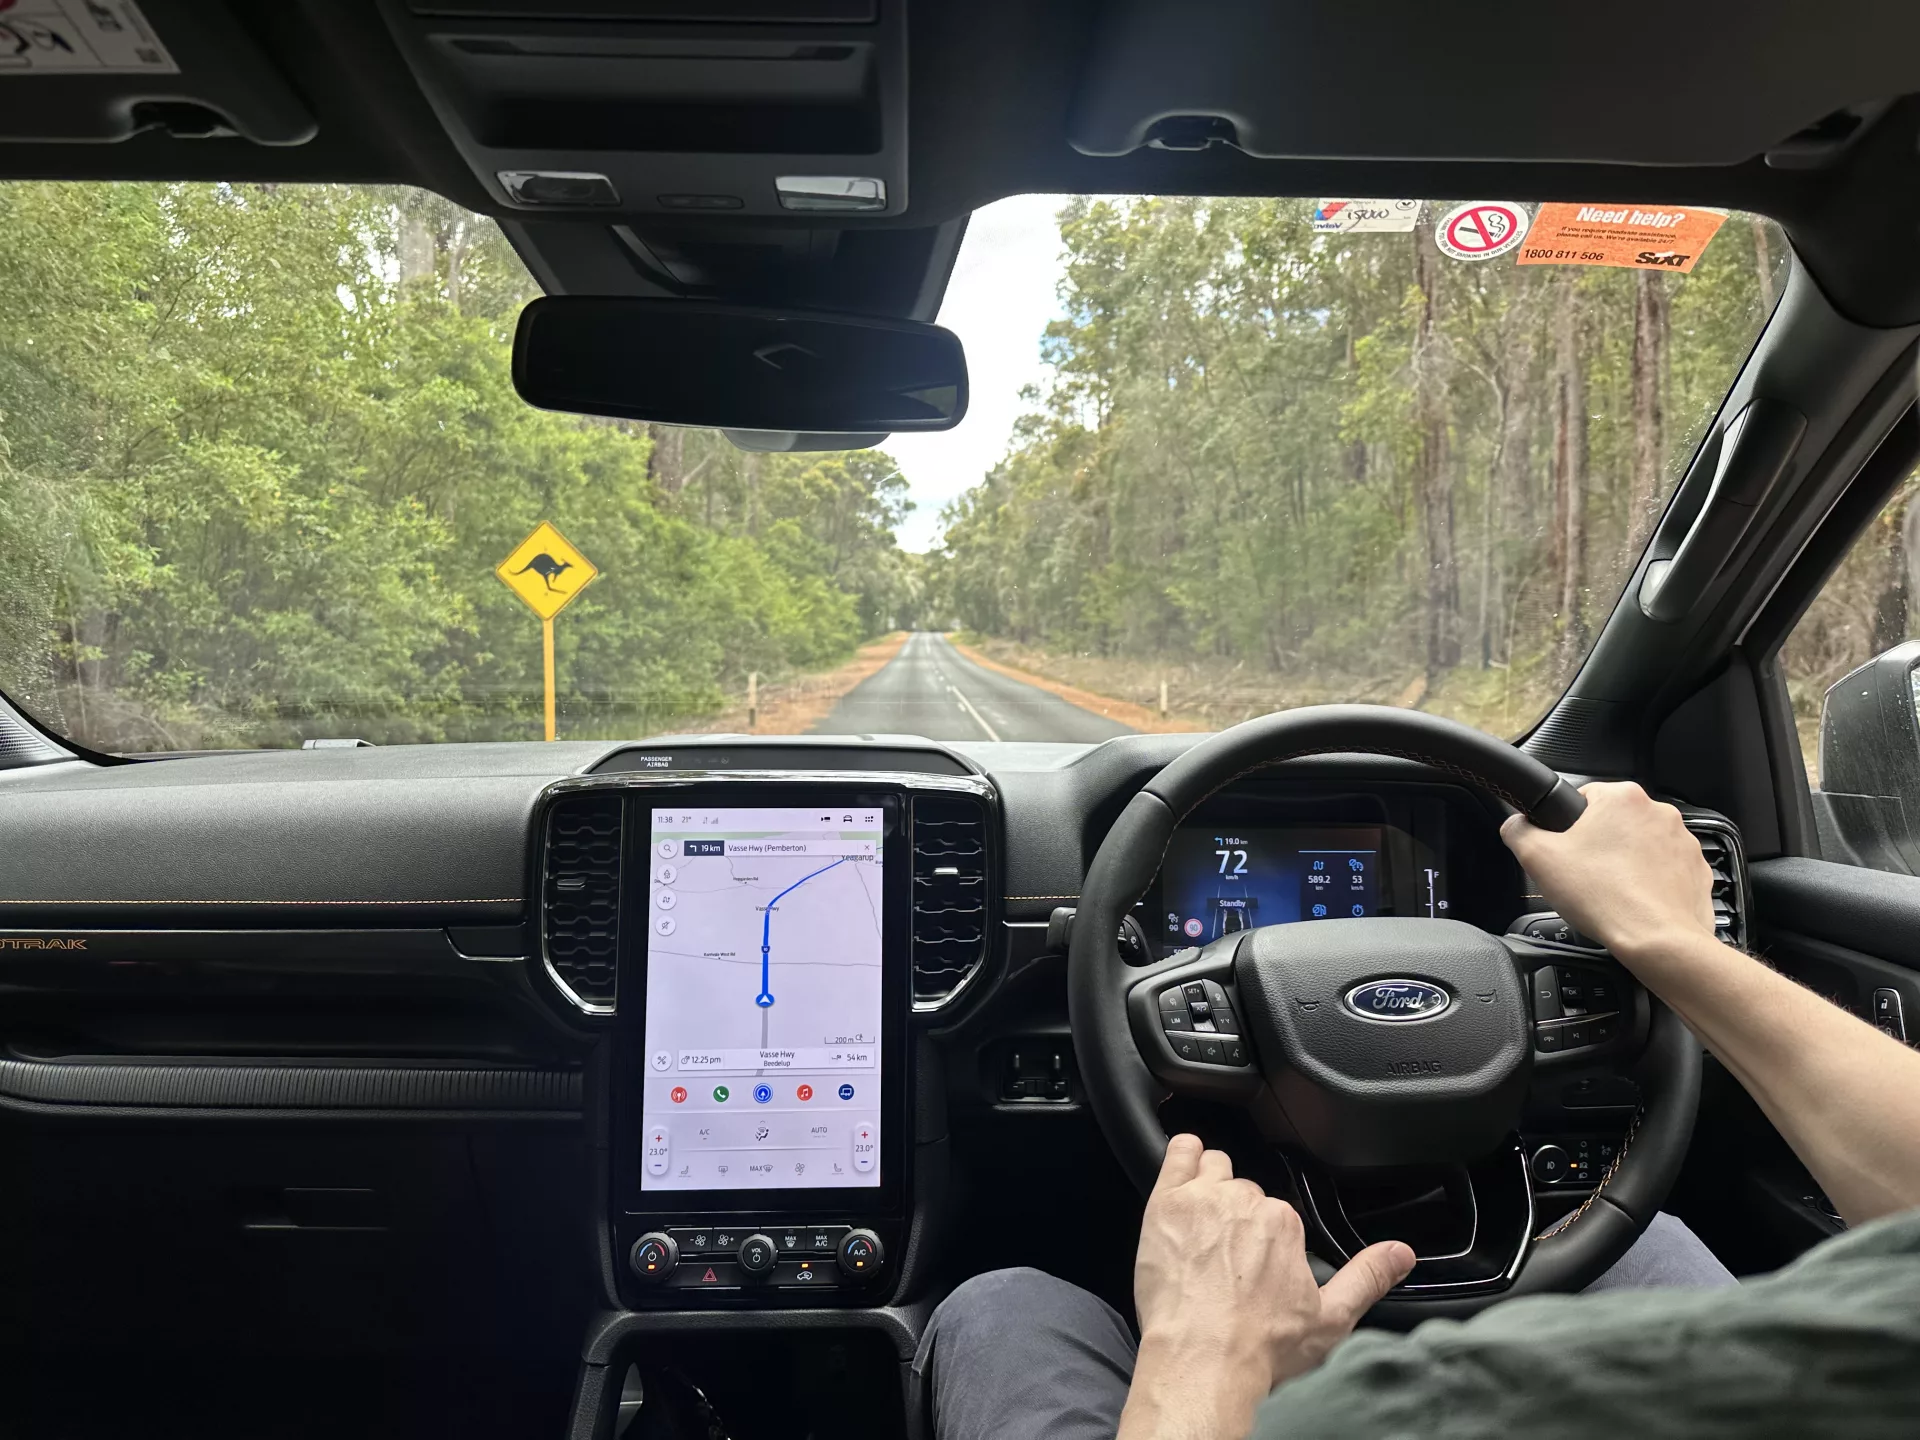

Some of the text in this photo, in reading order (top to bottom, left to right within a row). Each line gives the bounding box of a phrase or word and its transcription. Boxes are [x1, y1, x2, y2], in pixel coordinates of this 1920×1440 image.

[1575, 206, 1686, 228] Need help?
[1525, 248, 1604, 261] 1800 811 506
[709, 844, 721, 852] km
[748, 845, 763, 853] Hwy
[764, 844, 807, 853] (Pemberton)
[1215, 850, 1248, 874] 72
[1308, 875, 1363, 884] 589.2 53
[1169, 924, 1179, 932] 90
[0, 938, 87, 949] TRAK
[1372, 987, 1424, 1009] Ford
[780, 1051, 795, 1059] Hwy
[691, 1056, 721, 1065] 12:25 pm
[763, 1060, 791, 1068] Beedelup
[1385, 1061, 1442, 1076] AIRBAG
